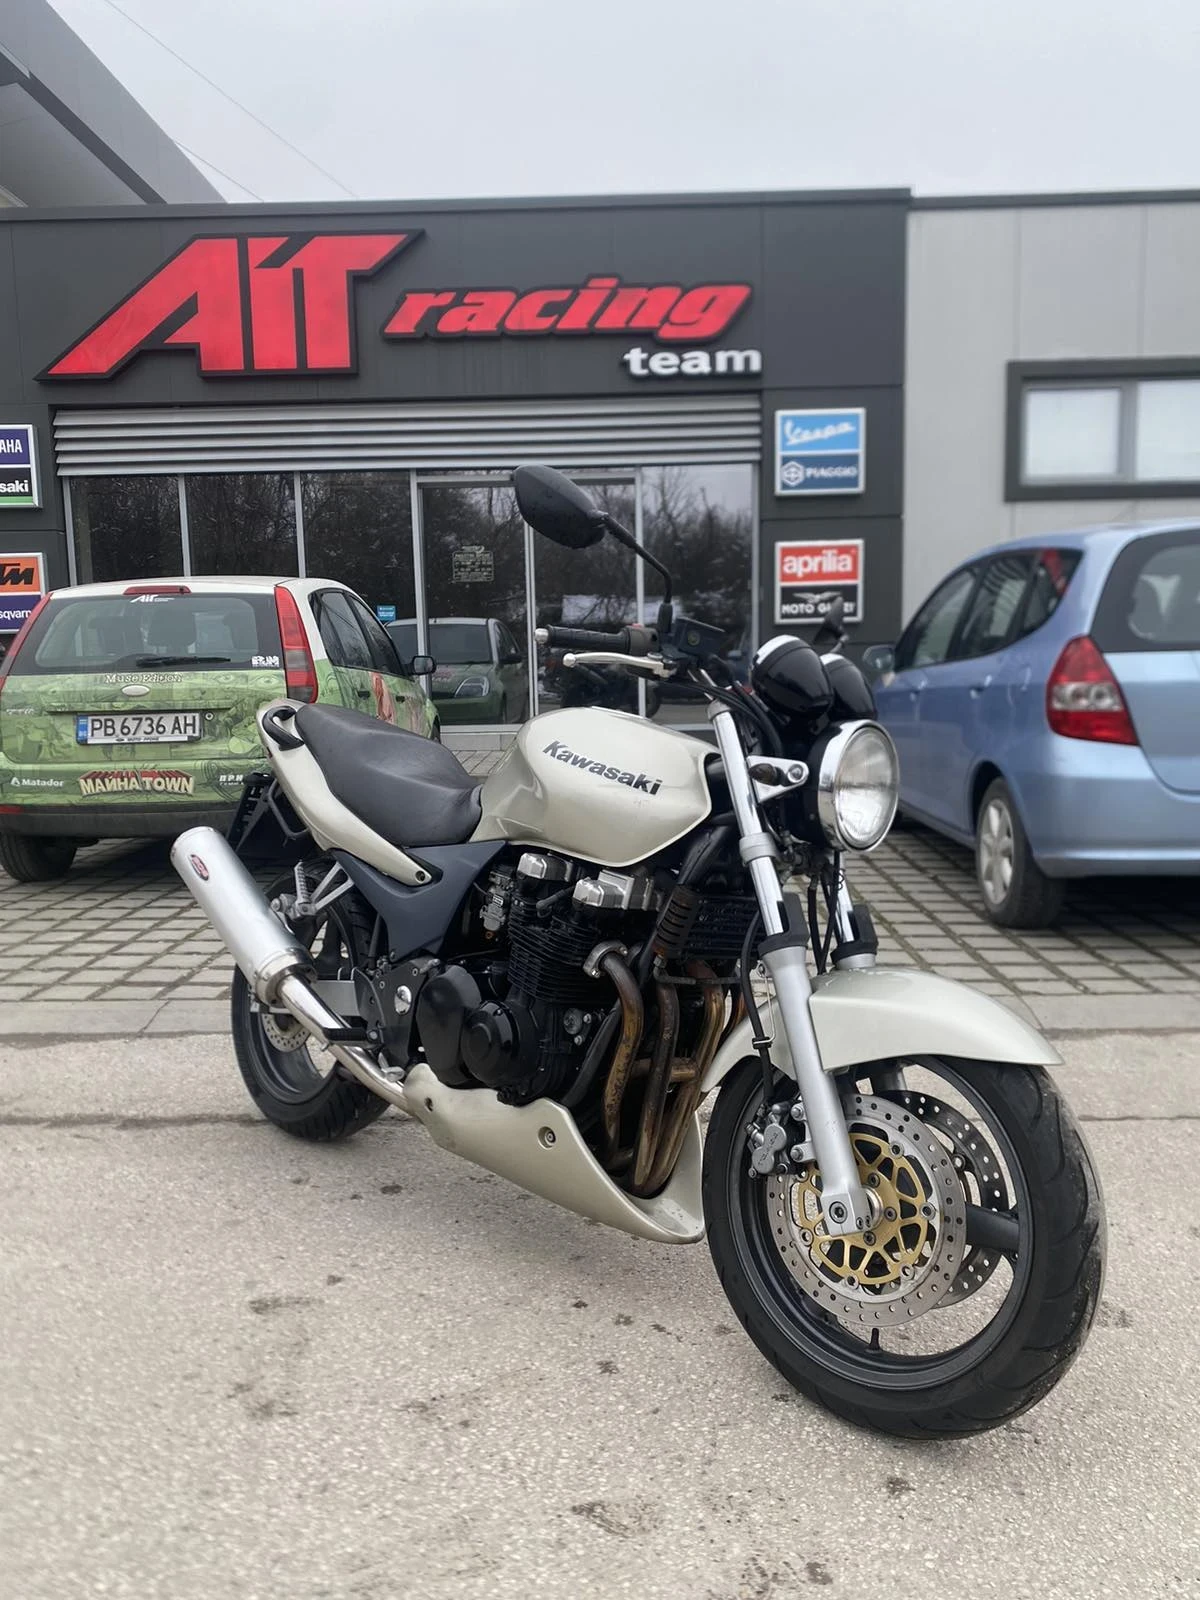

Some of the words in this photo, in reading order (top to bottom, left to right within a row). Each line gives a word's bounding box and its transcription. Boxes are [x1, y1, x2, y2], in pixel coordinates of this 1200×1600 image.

[384, 277, 751, 340] racing
[624, 347, 762, 376] team
[783, 548, 852, 578] aprilia
[781, 603, 815, 614] MOTO
[90, 718, 116, 737] PB
[120, 716, 166, 736] 6736
[171, 715, 197, 734] AH
[542, 740, 663, 796] Kawasaki
[21, 779, 65, 787] Matador
[140, 776, 194, 795] TOWN
